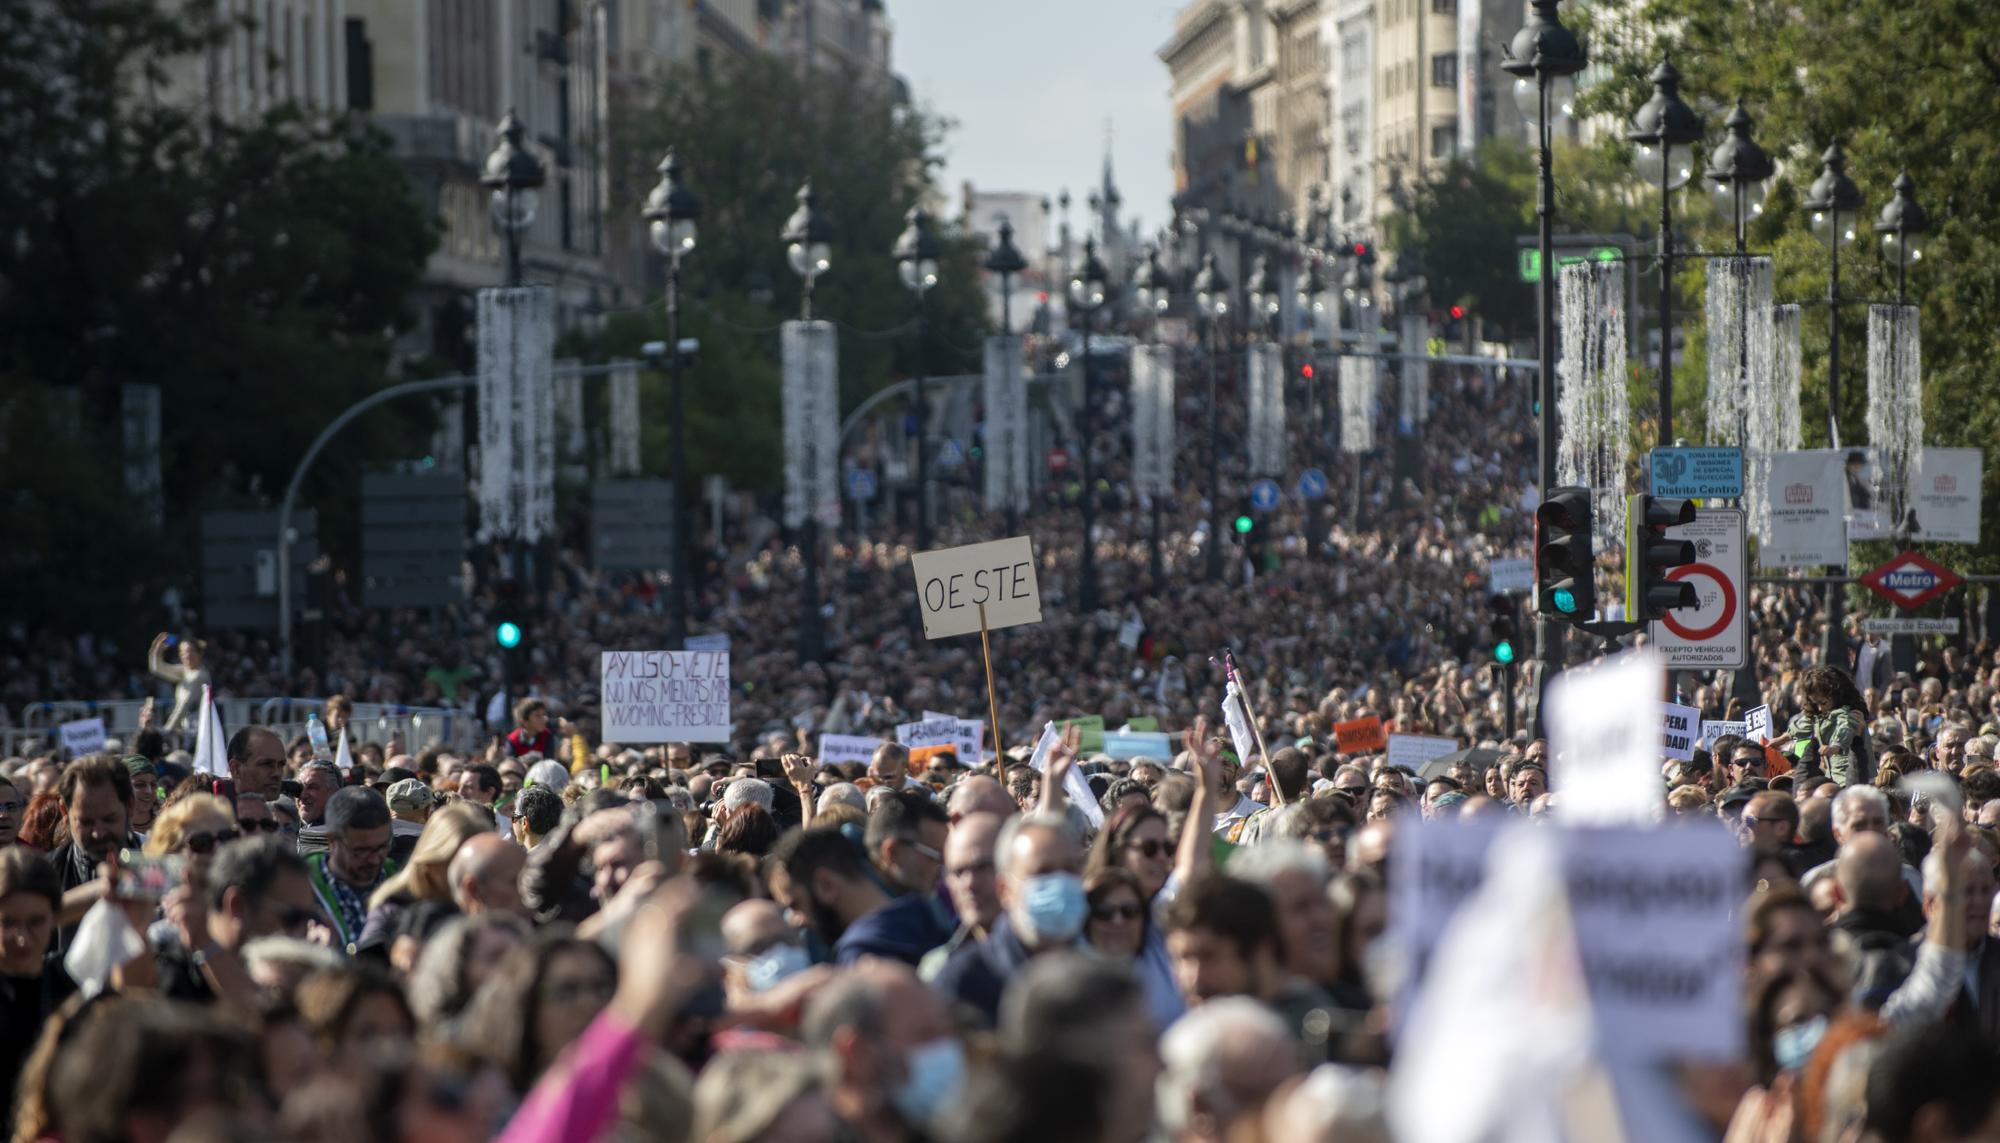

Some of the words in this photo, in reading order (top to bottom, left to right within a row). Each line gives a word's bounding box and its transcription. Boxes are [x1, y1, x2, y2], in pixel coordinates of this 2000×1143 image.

[1657, 485, 1697, 495] Distrito
[1699, 485, 1739, 494] Centro
[1889, 572, 1932, 586] Metro
[925, 562, 1030, 612] OESTE
[1868, 622, 1899, 631] Banco
[1901, 622, 1915, 631] de
[1917, 622, 1955, 632] España
[1694, 644, 1737, 653] VEHÍCULOS
[1671, 654, 1724, 662] AUTORIZADOS
[1664, 714, 1688, 731] PERA
